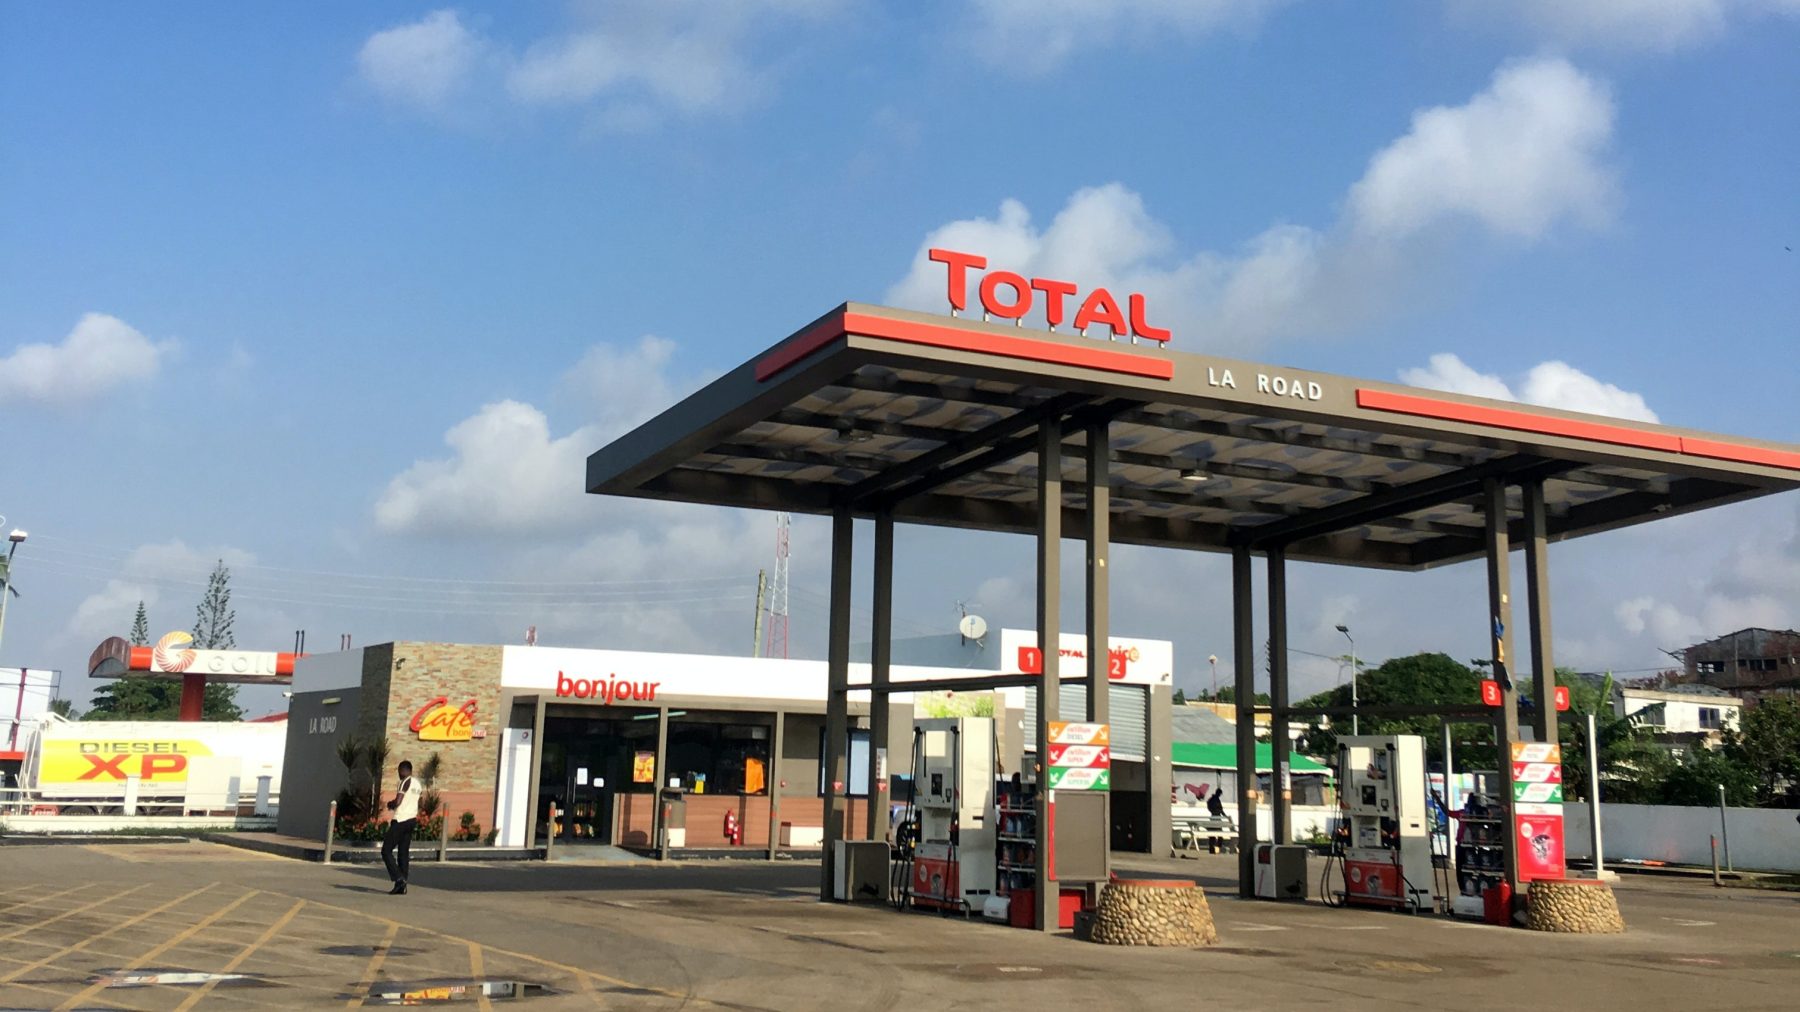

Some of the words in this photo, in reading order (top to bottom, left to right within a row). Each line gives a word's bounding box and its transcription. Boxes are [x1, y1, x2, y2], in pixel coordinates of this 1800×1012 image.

[929, 248, 1171, 342] TOTAL
[1208, 367, 1236, 389] LA
[1257, 373, 1322, 400] ROAD
[1027, 652, 1034, 667] 1
[1059, 649, 1085, 658] OTAL
[1111, 659, 1121, 675] 2
[556, 670, 661, 705] bonjour
[1488, 685, 1496, 701] 3
[1555, 691, 1564, 705] 4
[409, 695, 478, 737] Café
[309, 718, 318, 734] LA
[320, 716, 337, 734] ROAD
[80, 743, 187, 753] DIESEL
[76, 754, 188, 780] XP
